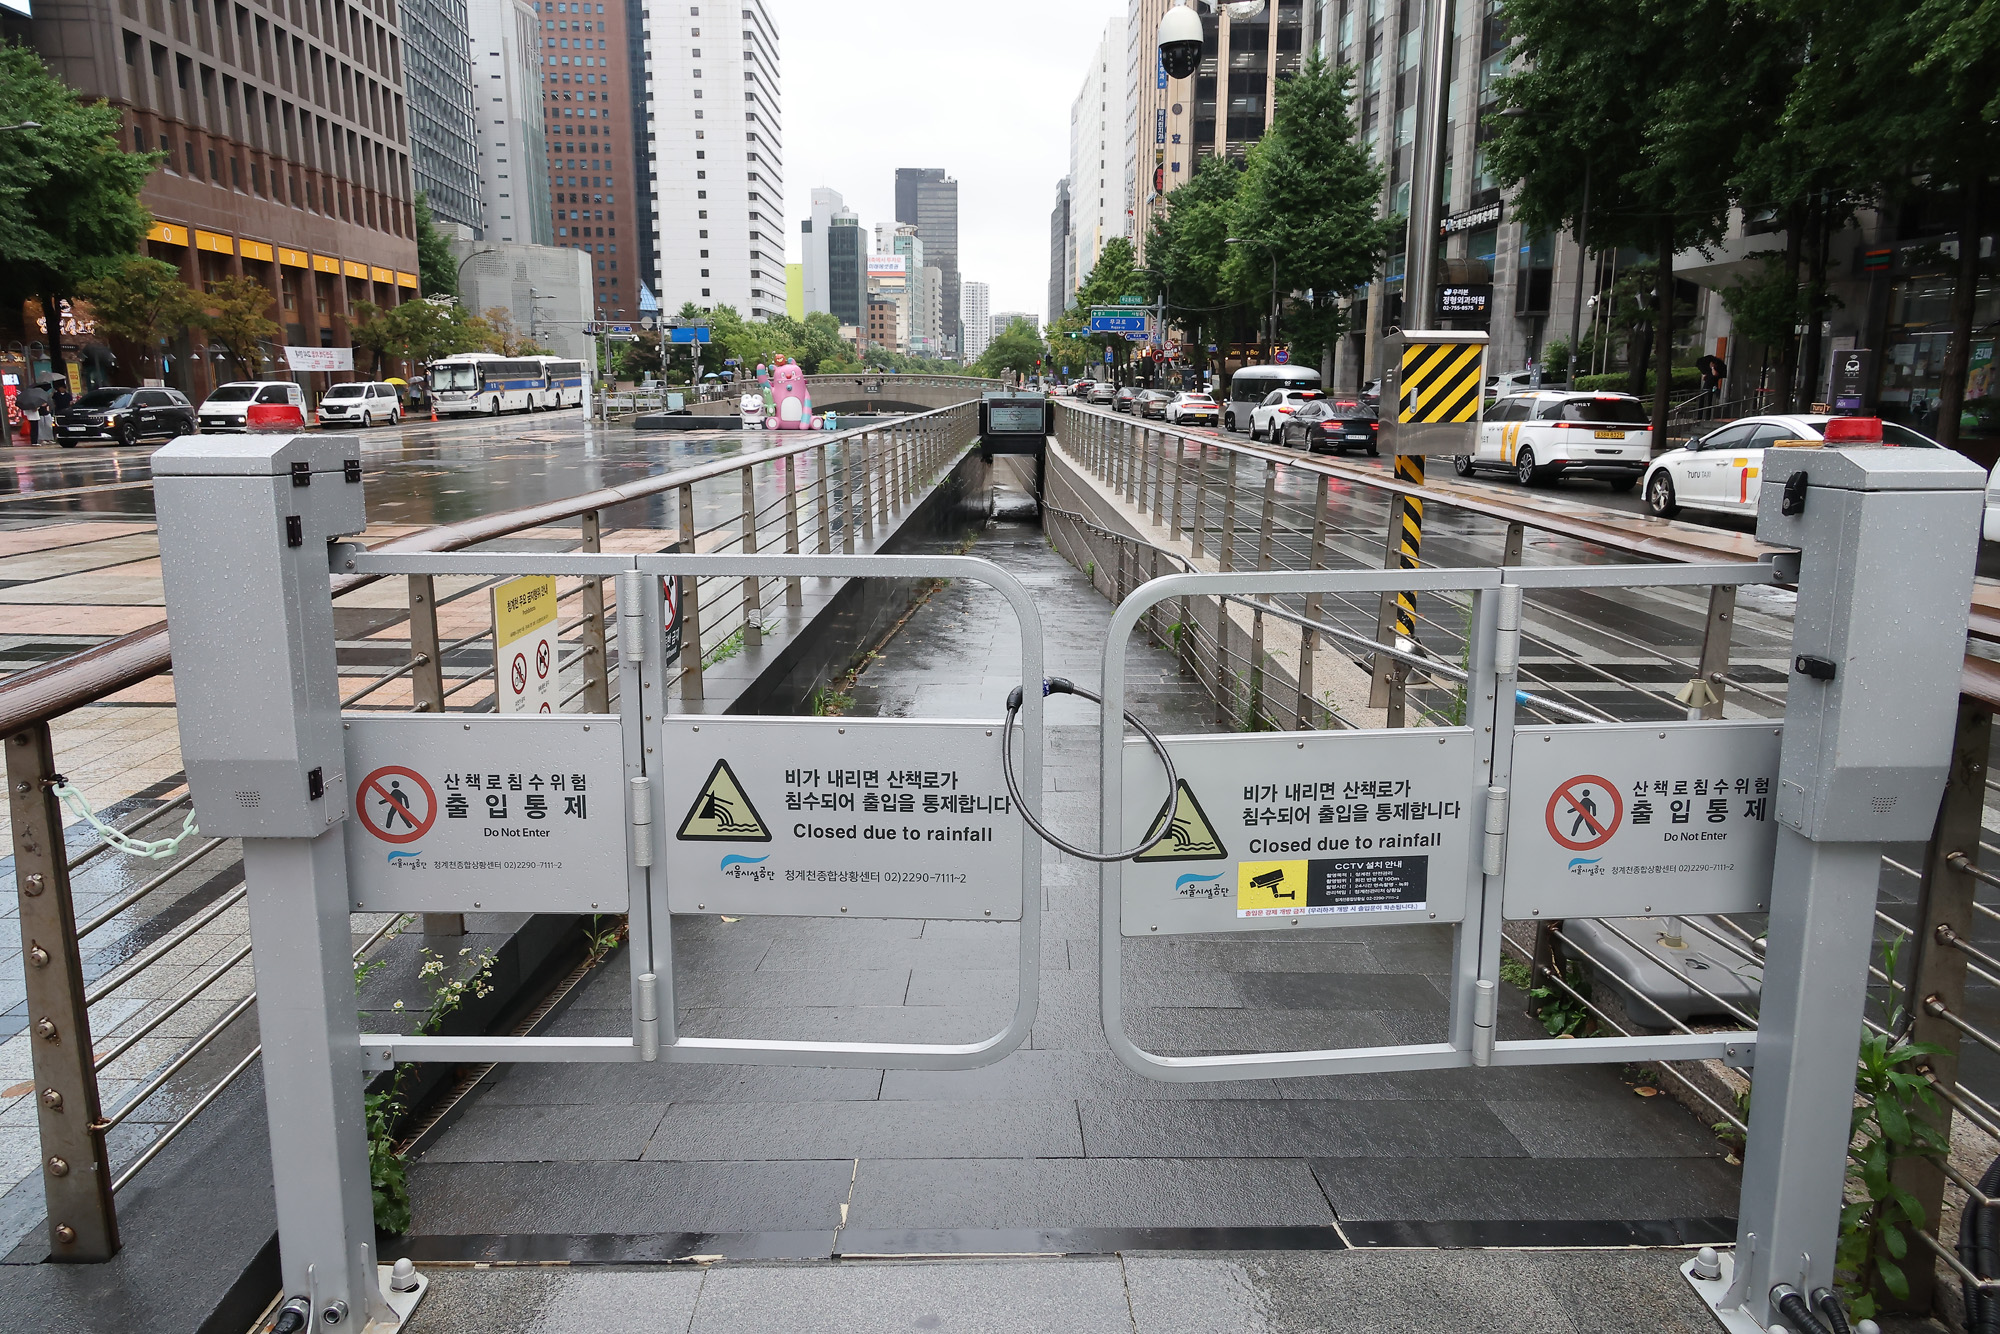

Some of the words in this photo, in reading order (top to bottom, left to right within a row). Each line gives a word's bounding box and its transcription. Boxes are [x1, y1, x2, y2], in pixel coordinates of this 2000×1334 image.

[1452, 288, 1469, 296] 우리본
[1443, 296, 1485, 305] 정형외과의원
[785, 769, 820, 788] 비가
[827, 769, 879, 790] 내리면
[887, 770, 958, 791] 산책로가
[1243, 784, 1278, 803] 비가
[1285, 782, 1335, 802] 내리면
[1343, 780, 1411, 800] 산책로가
[785, 792, 854, 812] 침수되어
[862, 794, 916, 814] 출입을
[922, 794, 1012, 814] 통제합니다
[1242, 805, 1310, 826] 침수되어
[1317, 804, 1369, 824] 출입을
[1375, 801, 1461, 822] 통제합니다
[484, 828, 499, 838] Do
[501, 828, 520, 838] Not
[522, 828, 550, 838] Enter
[793, 823, 857, 840] Closed
[863, 824, 897, 840] due
[902, 826, 921, 842] to
[927, 826, 992, 842] rainfall
[1664, 832, 1679, 842] Do
[1680, 832, 1700, 841] Not
[1701, 832, 1728, 841] Enter
[1250, 836, 1312, 854] Closed
[1317, 834, 1350, 852] due
[1355, 834, 1373, 850] to
[1378, 832, 1441, 849] rainfall
[391, 858, 427, 870] 서울시설공단
[434, 861, 502, 870] 청계천종합상황센터
[1334, 862, 1364, 870] CCTV
[1366, 861, 1384, 870] 설치
[1384, 860, 1402, 868] 안내
[1571, 864, 1605, 876] 서울시설공단
[1612, 865, 1677, 875] 청계천종합상황센터
[1678, 863, 1734, 873] 02)2290-7111~2
[726, 866, 776, 882] 서울시설공단
[784, 869, 881, 884] 청계천종합상황센터
[884, 872, 966, 884] 02)2290-7111~2
[1180, 884, 1230, 899] 서울시설공단
